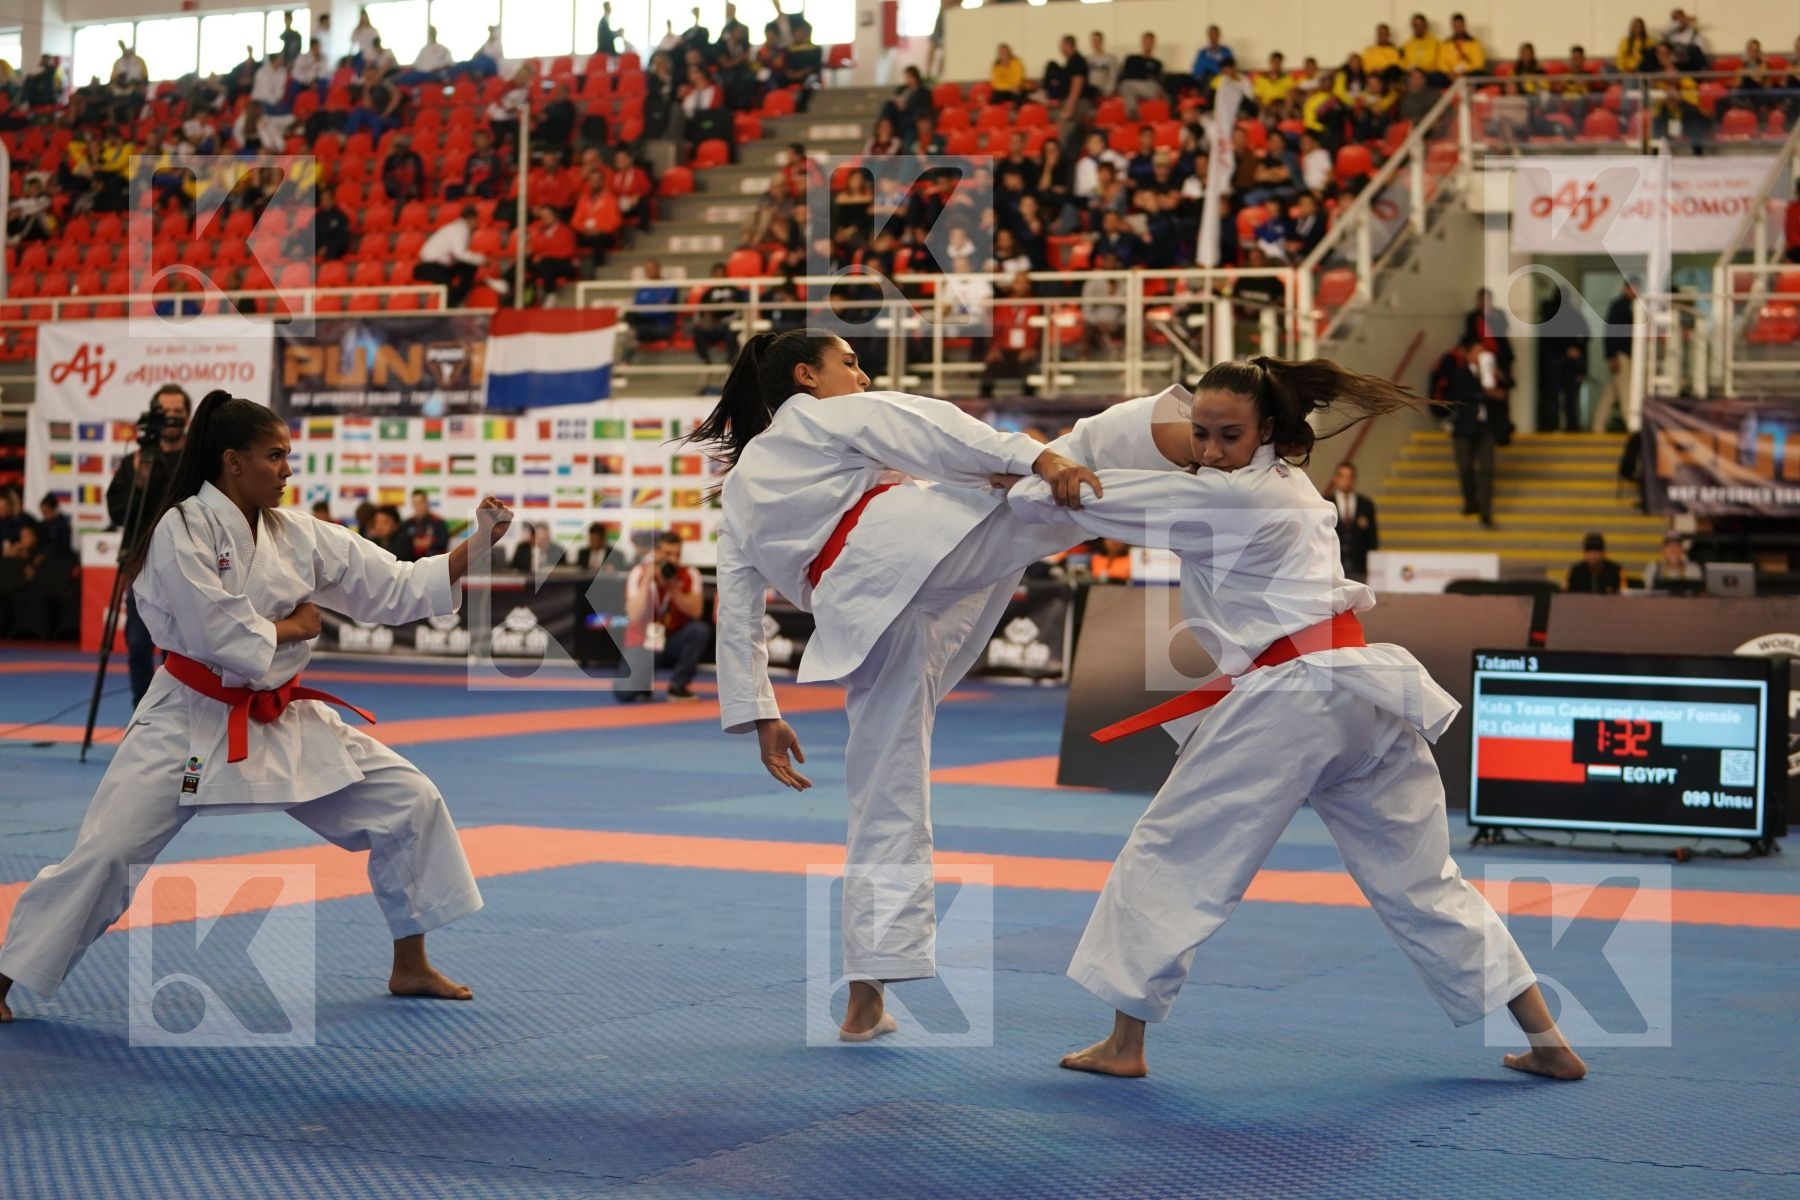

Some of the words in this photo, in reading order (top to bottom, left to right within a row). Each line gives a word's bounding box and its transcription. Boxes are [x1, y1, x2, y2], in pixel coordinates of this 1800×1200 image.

[124, 360, 256, 386] AJINOMOTO
[1476, 655, 1526, 671] Tatami
[1527, 657, 1539, 672] 3
[1478, 700, 1512, 715] Kata
[1515, 701, 1556, 716] Team
[1604, 705, 1633, 719] and
[1635, 705, 1682, 721] Junior
[1686, 707, 1741, 723] Female
[1501, 721, 1537, 735] Gold
[1597, 718, 1652, 757] 1:32
[1622, 765, 1678, 785] EGYPT
[1682, 790, 1711, 807] 099
[1712, 791, 1753, 809] Unsu
